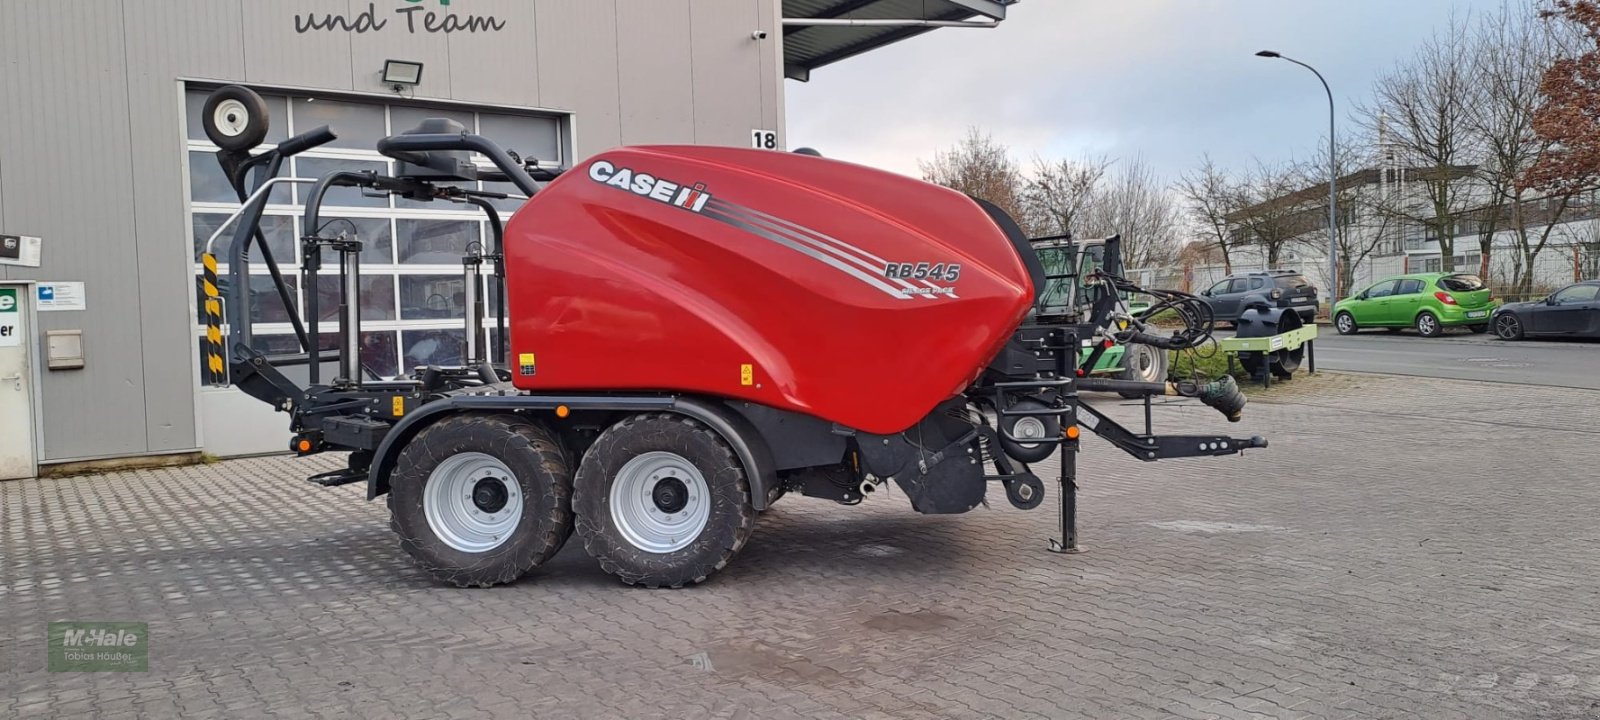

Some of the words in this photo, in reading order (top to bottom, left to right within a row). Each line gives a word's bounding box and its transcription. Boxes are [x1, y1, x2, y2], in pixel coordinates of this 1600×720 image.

[294, 2, 387, 33] und
[395, 5, 506, 33] Team
[754, 131, 776, 149] 18
[588, 160, 678, 203] CASE
[885, 262, 961, 282] RB545
